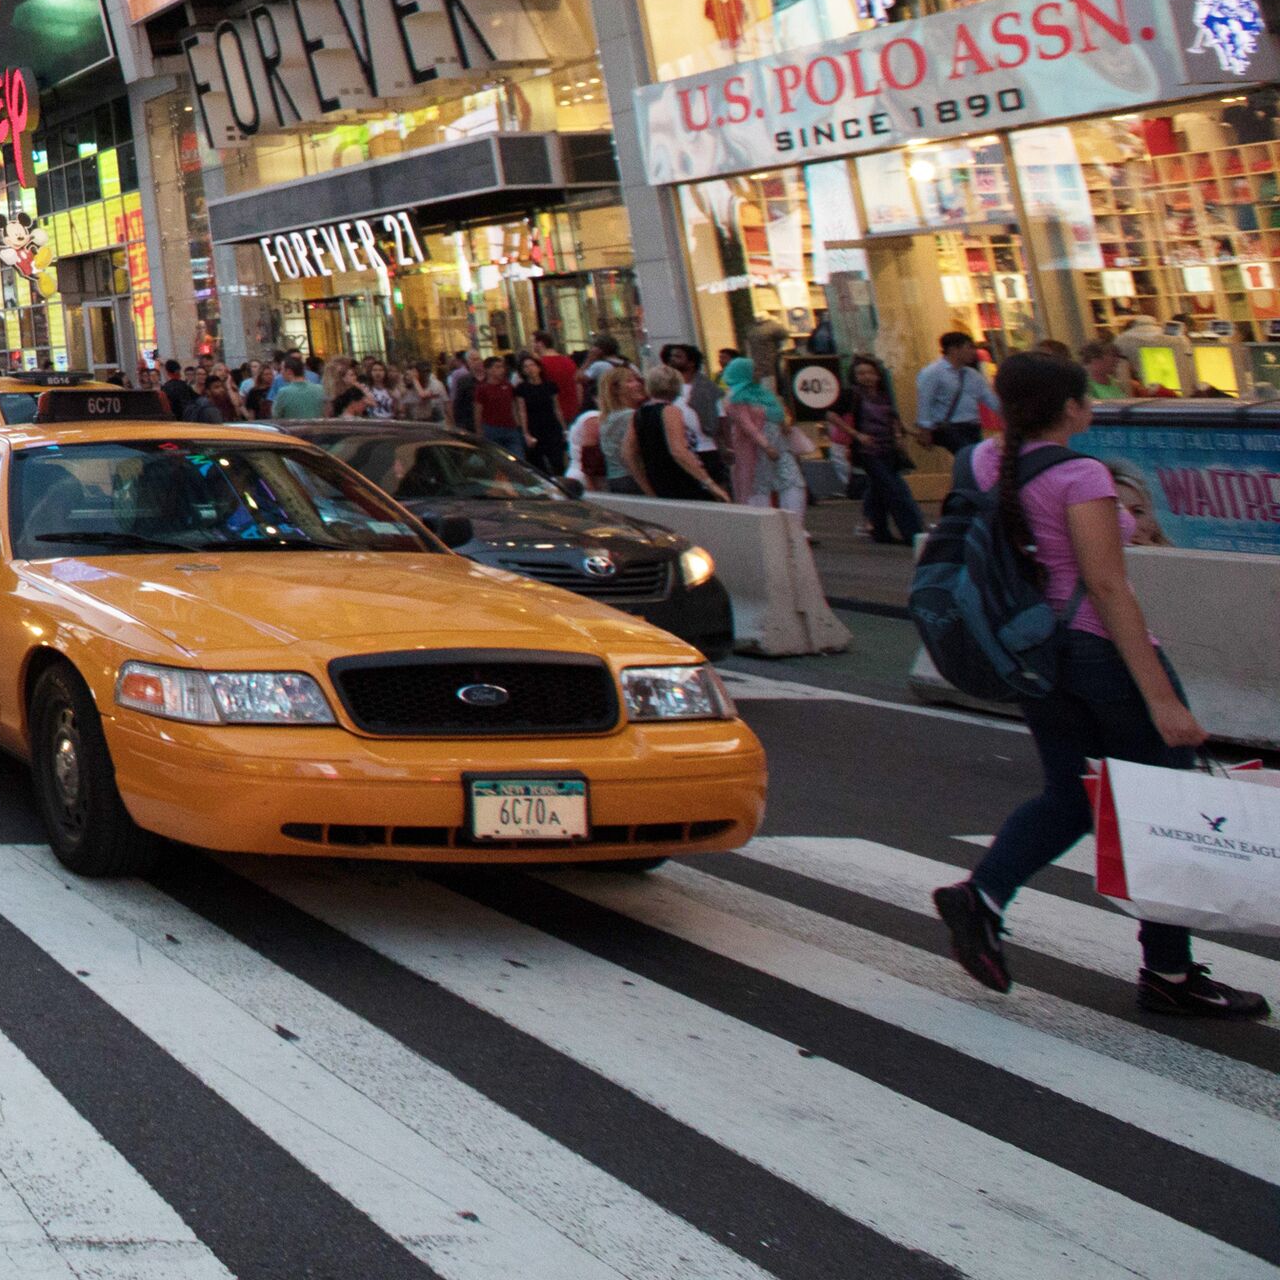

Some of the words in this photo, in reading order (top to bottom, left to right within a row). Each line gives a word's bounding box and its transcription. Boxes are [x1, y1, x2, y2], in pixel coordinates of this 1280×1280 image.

[678, 80, 765, 134] U.S.
[773, 35, 928, 114] POLO
[775, 111, 892, 152] SINCE
[914, 86, 1026, 131] 1890
[259, 217, 390, 283] FOREVER
[382, 210, 426, 266] 21
[88, 397, 122, 414] 6C70
[500, 797, 561, 826] 6C70A
[1149, 824, 1235, 853] AMERICAN
